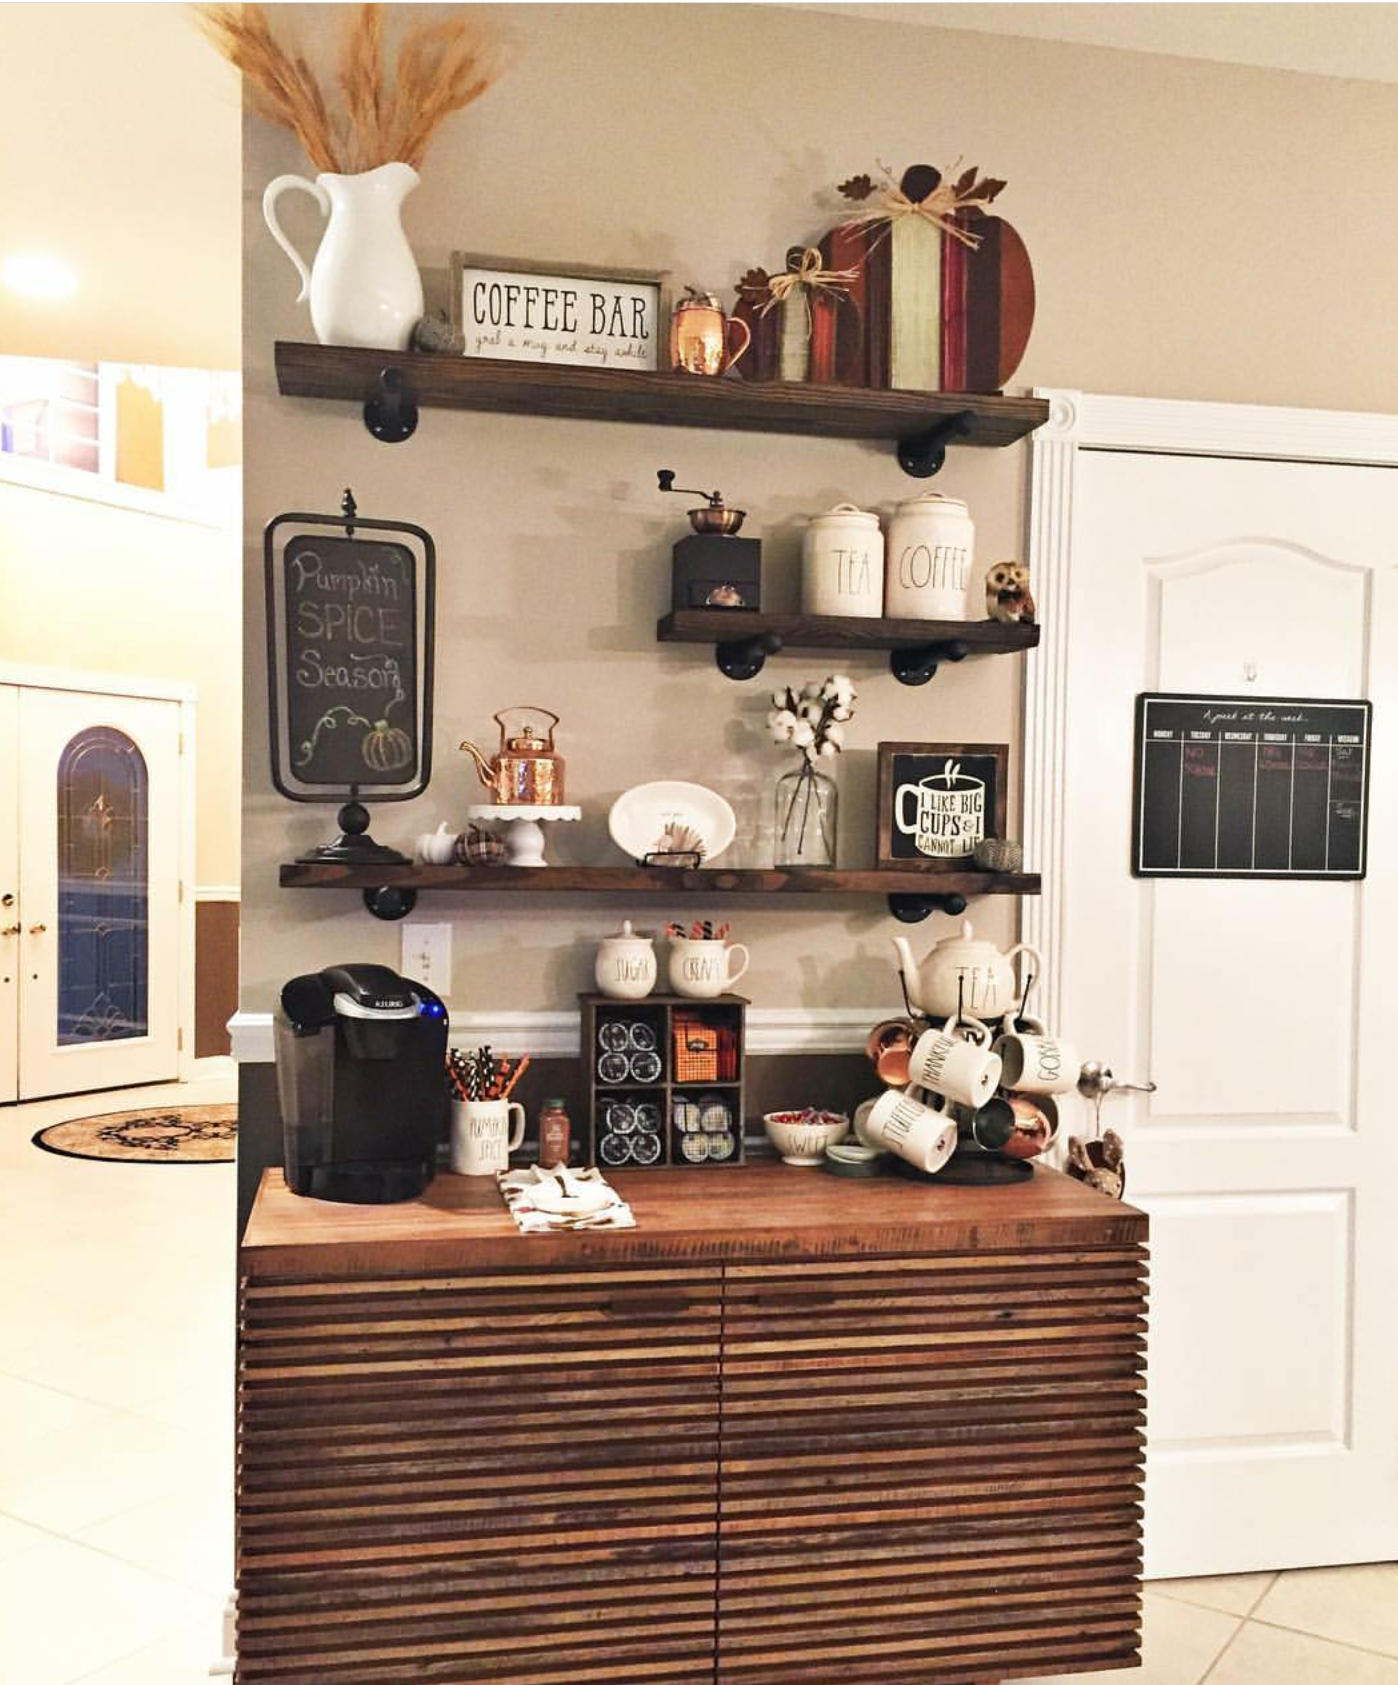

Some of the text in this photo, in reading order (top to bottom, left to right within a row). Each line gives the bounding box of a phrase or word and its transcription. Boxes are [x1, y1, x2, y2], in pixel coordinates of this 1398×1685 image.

[473, 282, 649, 340] COFFEE BAR
[475, 330, 501, 354] grab
[508, 340, 516, 348] a
[523, 339, 547, 358] mug
[555, 341, 577, 352] and
[583, 343, 609, 364] stay
[291, 551, 398, 601] Pumpkin
[830, 549, 872, 596] TEA
[899, 545, 968, 591] COFFEE
[297, 601, 404, 647] SPICE
[296, 649, 400, 688] Season
[920, 792, 982, 815] I LIKE BIG
[920, 810, 961, 837] CUPS
[975, 815, 981, 836] I
[955, 965, 998, 1010] TEA
